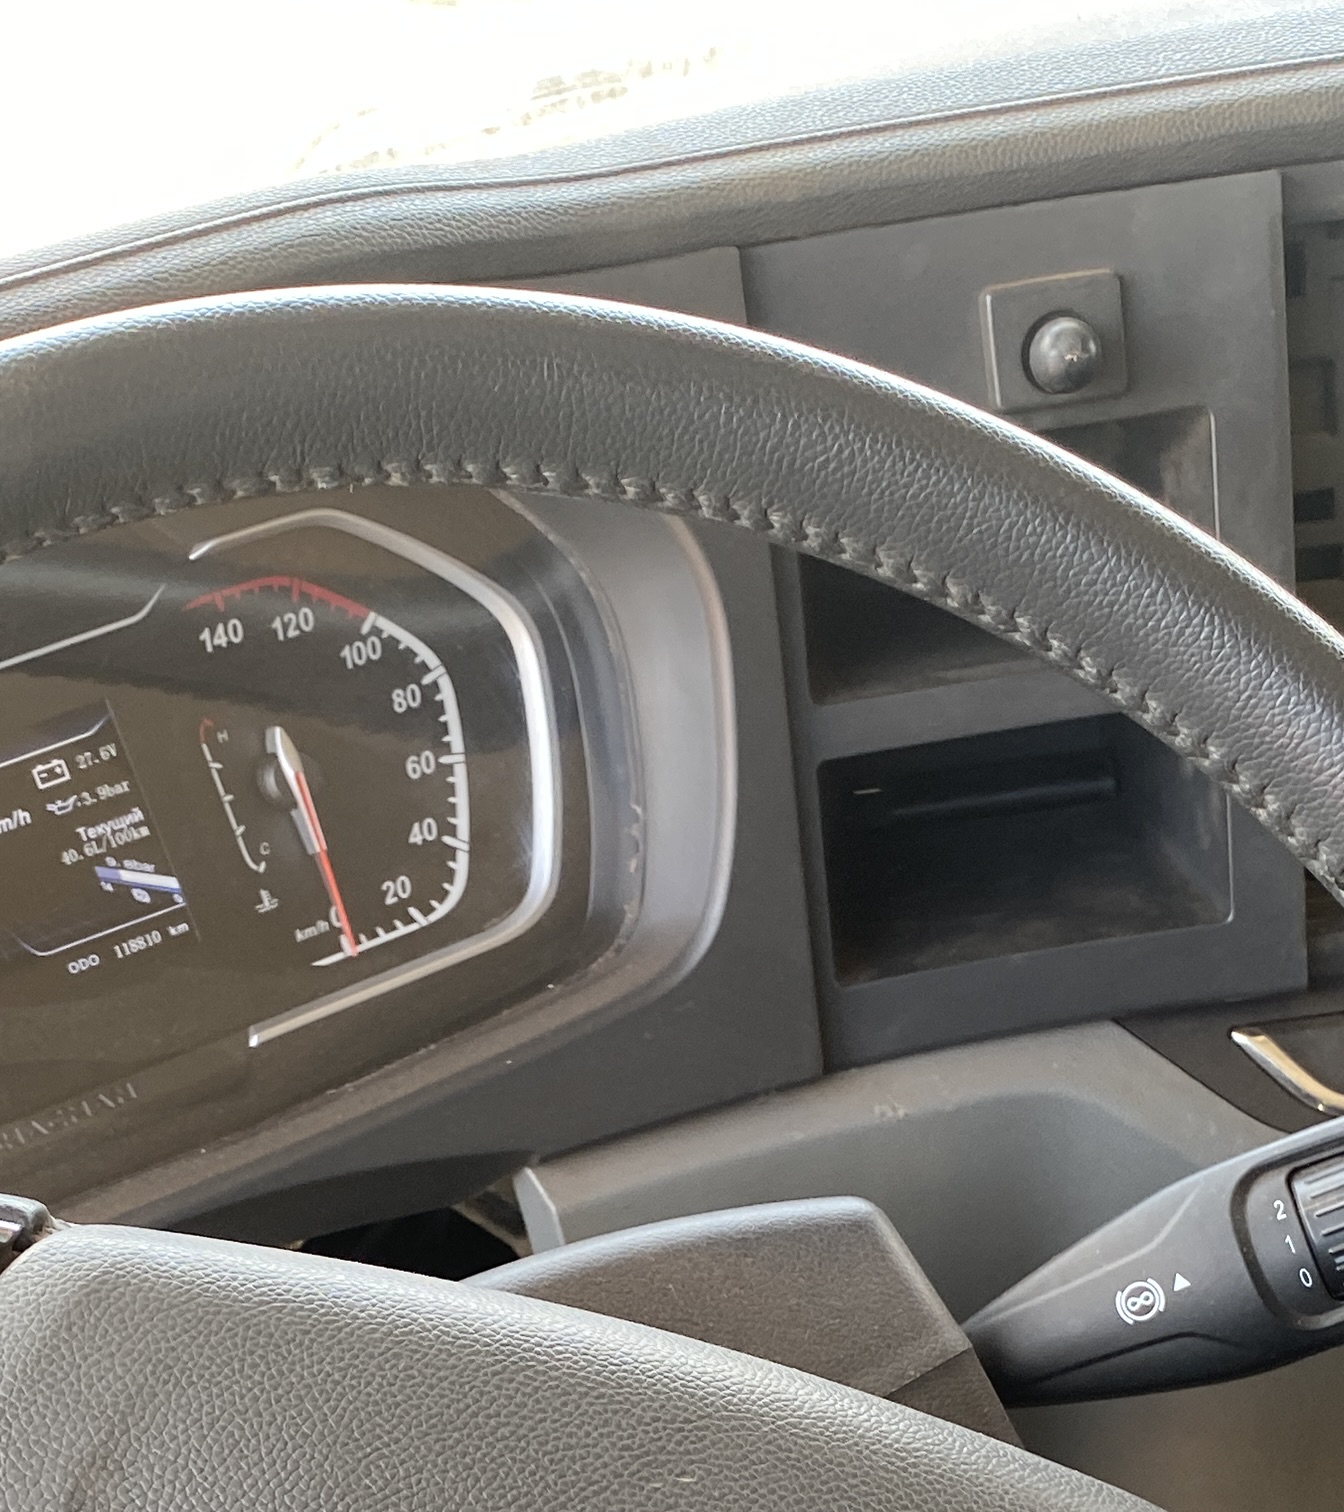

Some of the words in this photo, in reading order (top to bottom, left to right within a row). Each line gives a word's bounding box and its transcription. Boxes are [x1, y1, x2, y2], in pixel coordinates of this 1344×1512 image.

[199, 618, 244, 653] 140
[270, 607, 315, 641] 120
[339, 635, 382, 669] 100
[392, 683, 422, 713] 80
[405, 751, 435, 779] 60
[408, 817, 438, 845] 40
[259, 842, 270, 855] C
[381, 875, 411, 905] 20
[295, 920, 330, 942] km/h
[67, 954, 100, 974] ODO
[113, 930, 162, 958] 118810
[167, 922, 189, 936] km
[1273, 1200, 1287, 1220] 2
[1285, 1235, 1296, 1253] 1
[1299, 1268, 1312, 1287] 0
